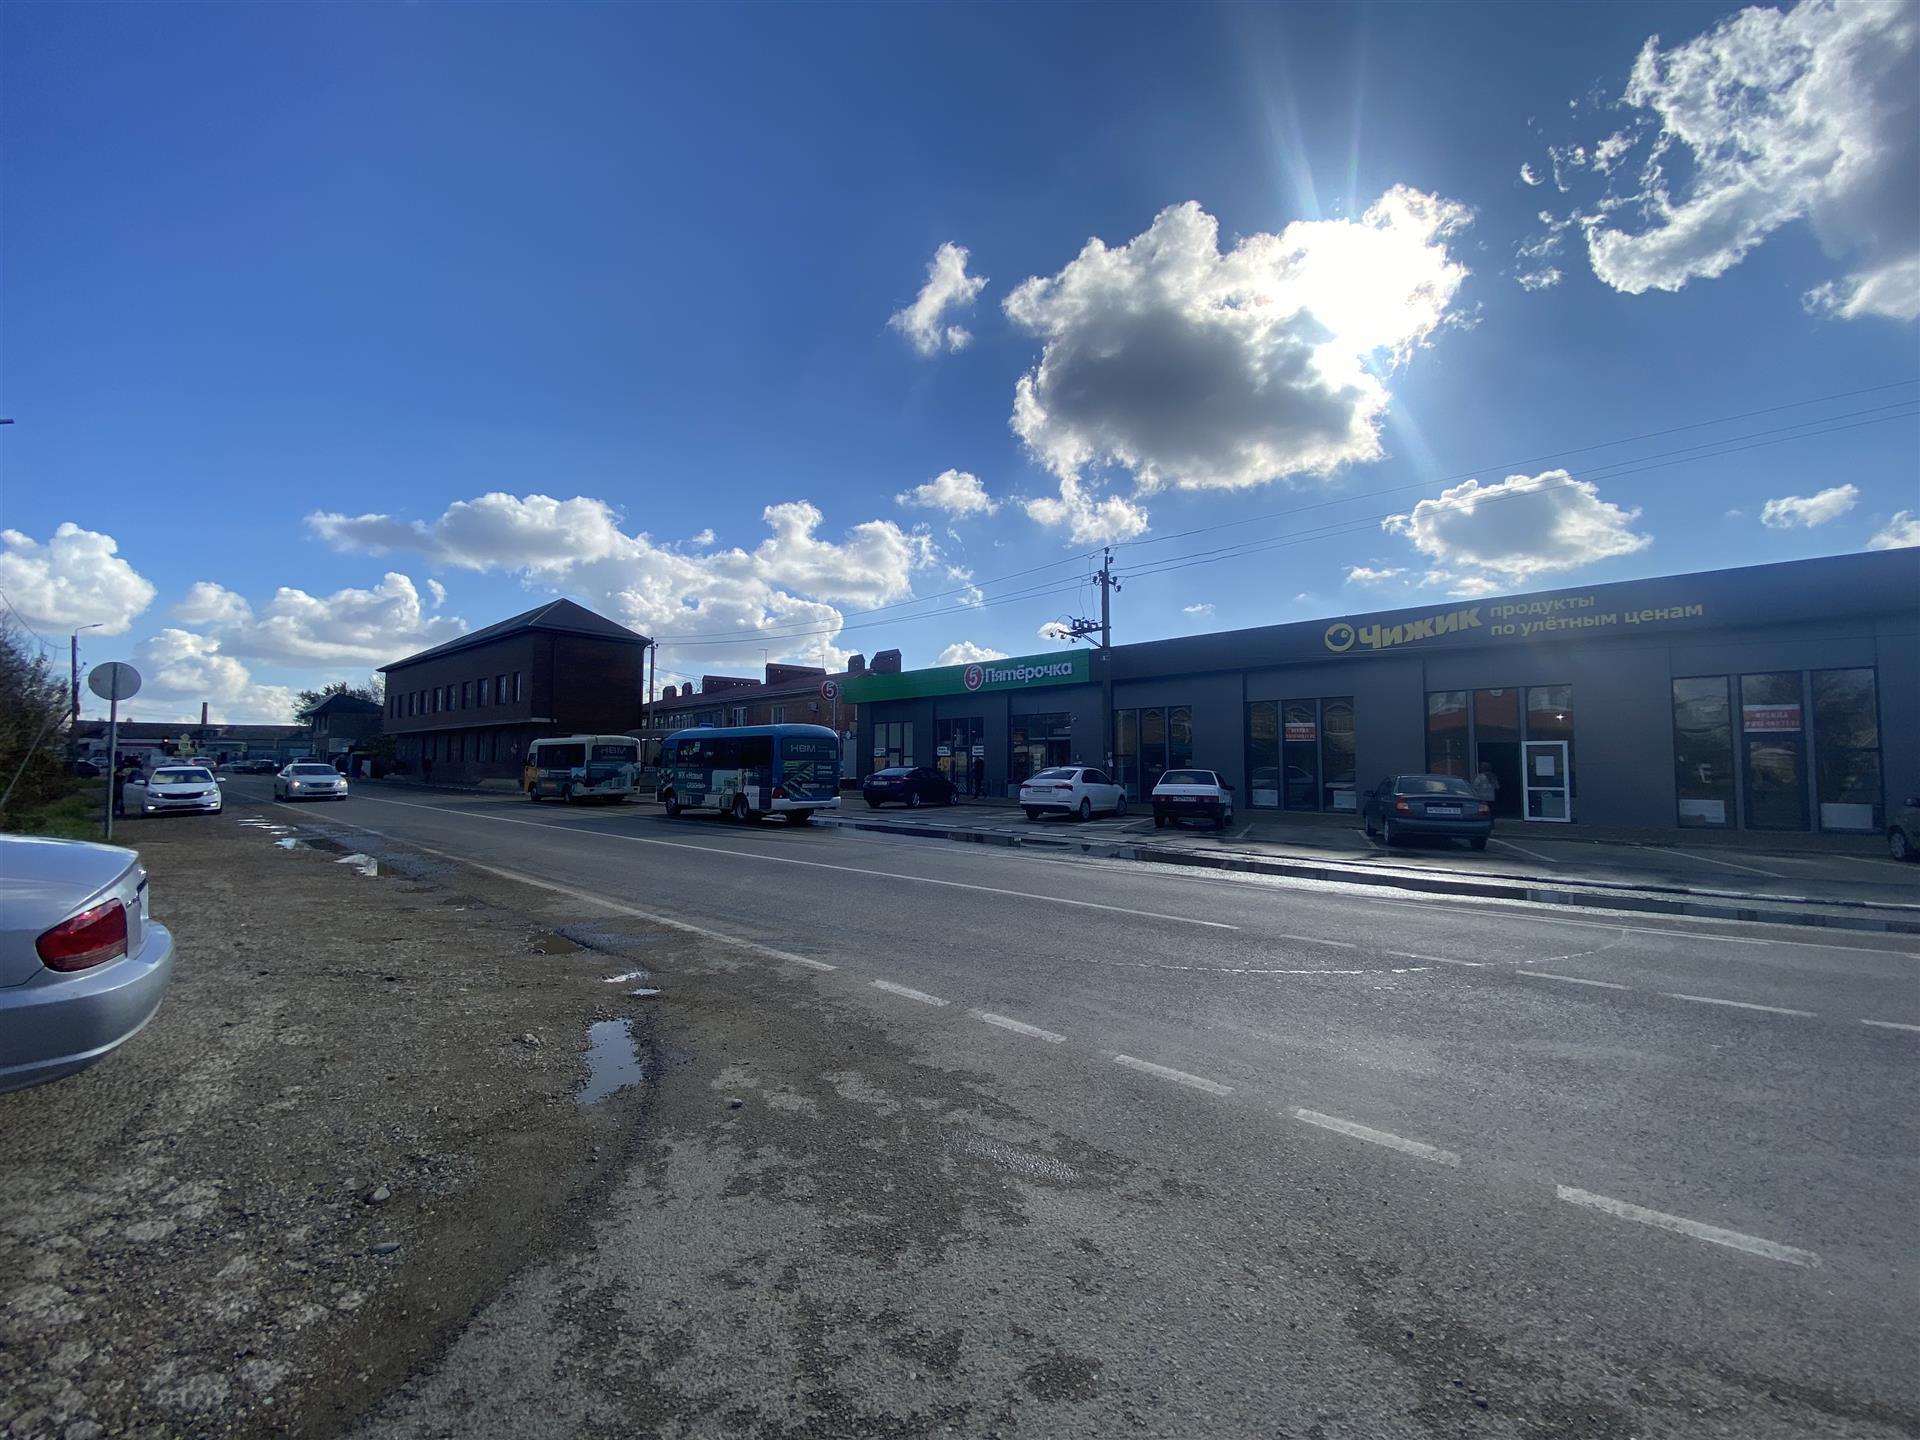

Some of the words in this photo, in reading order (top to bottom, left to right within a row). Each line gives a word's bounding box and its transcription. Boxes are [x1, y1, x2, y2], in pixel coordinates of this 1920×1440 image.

[1490, 596, 1595, 619] продукты
[1491, 622, 1515, 636] по
[1521, 613, 1617, 637] улётным
[1624, 604, 1703, 625] ценам
[985, 662, 1073, 683] Пятёрочка
